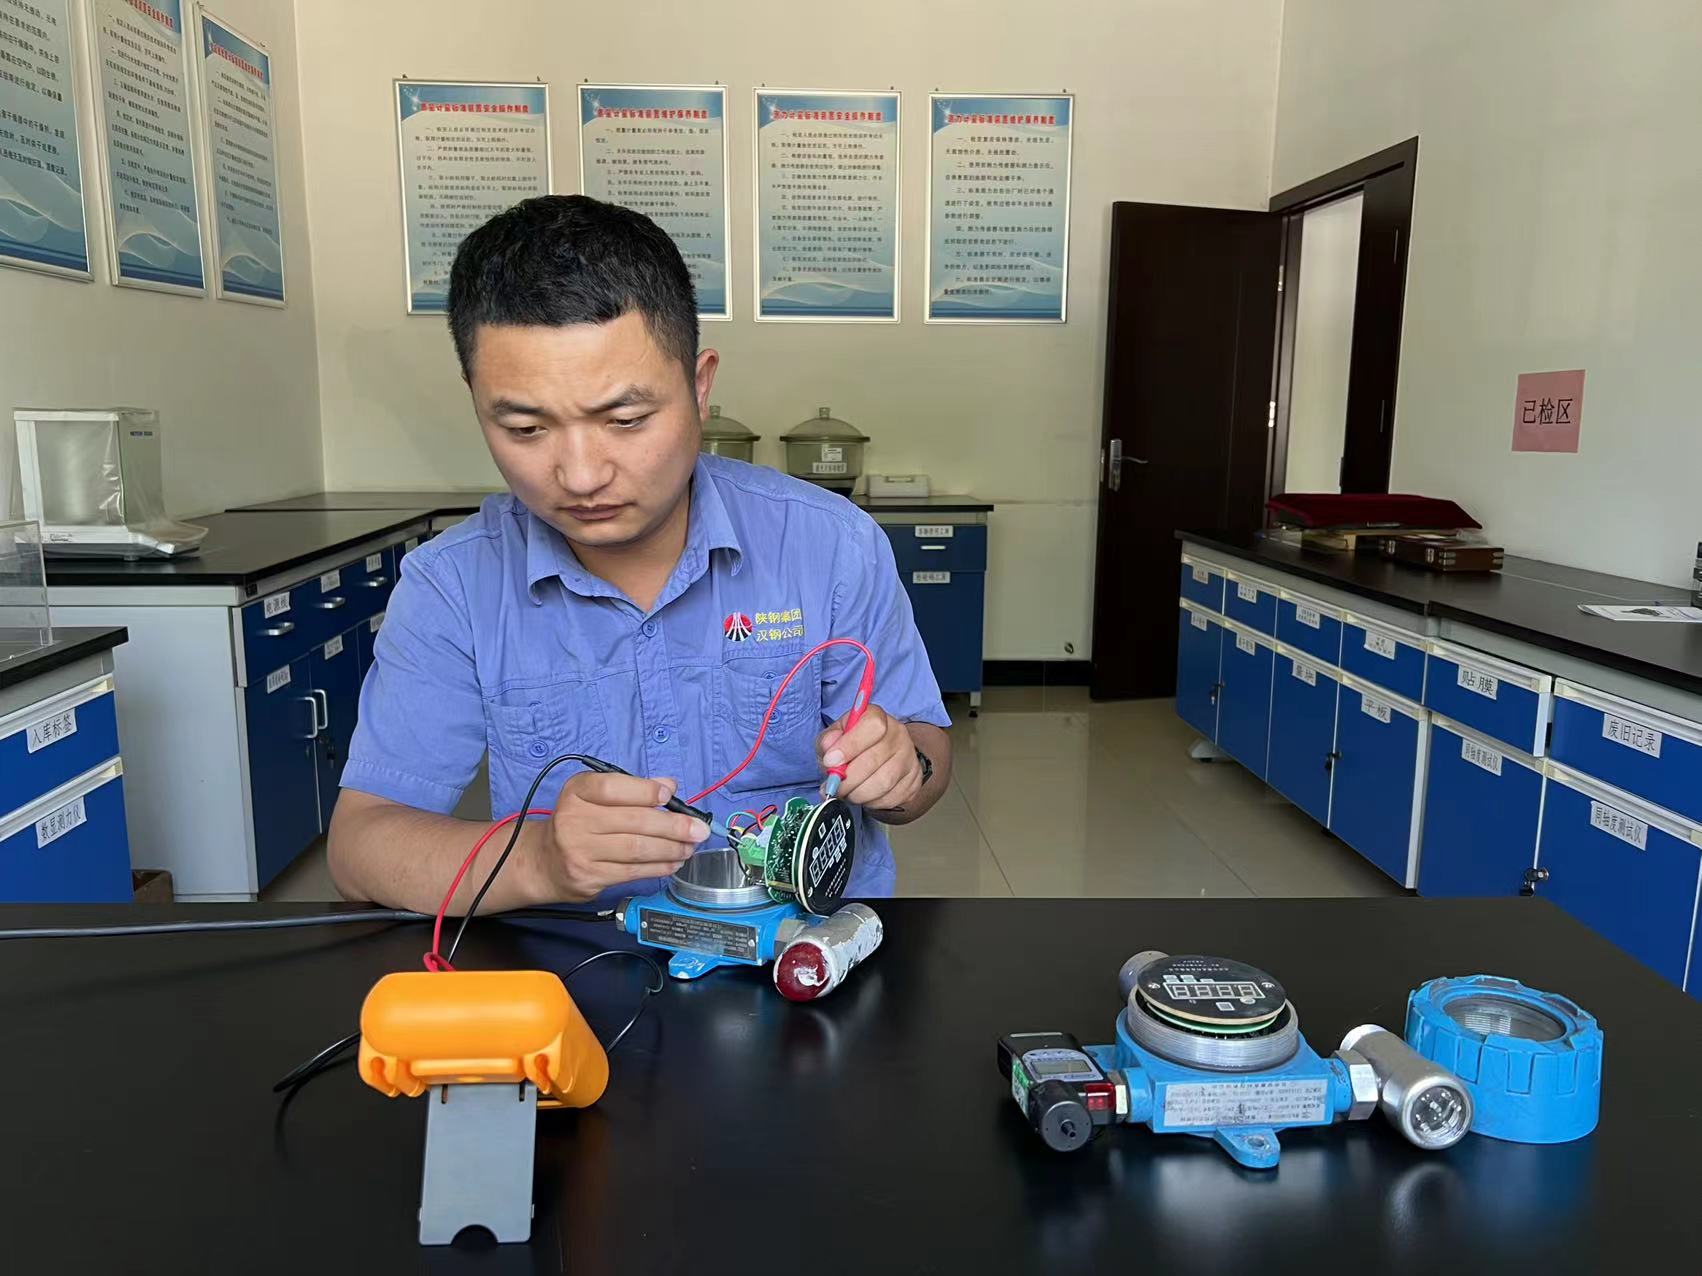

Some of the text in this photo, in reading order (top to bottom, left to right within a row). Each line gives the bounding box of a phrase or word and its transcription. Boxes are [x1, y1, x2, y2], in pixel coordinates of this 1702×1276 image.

[1522, 398, 1573, 425] 已检区
[755, 608, 802, 624] 陕钢集团
[756, 624, 804, 642] 汉钢公司
[1461, 670, 1494, 695] 贴膜
[1364, 698, 1388, 722] 平板
[32, 714, 72, 748] 入库标签
[1607, 720, 1656, 752] 废旧记录
